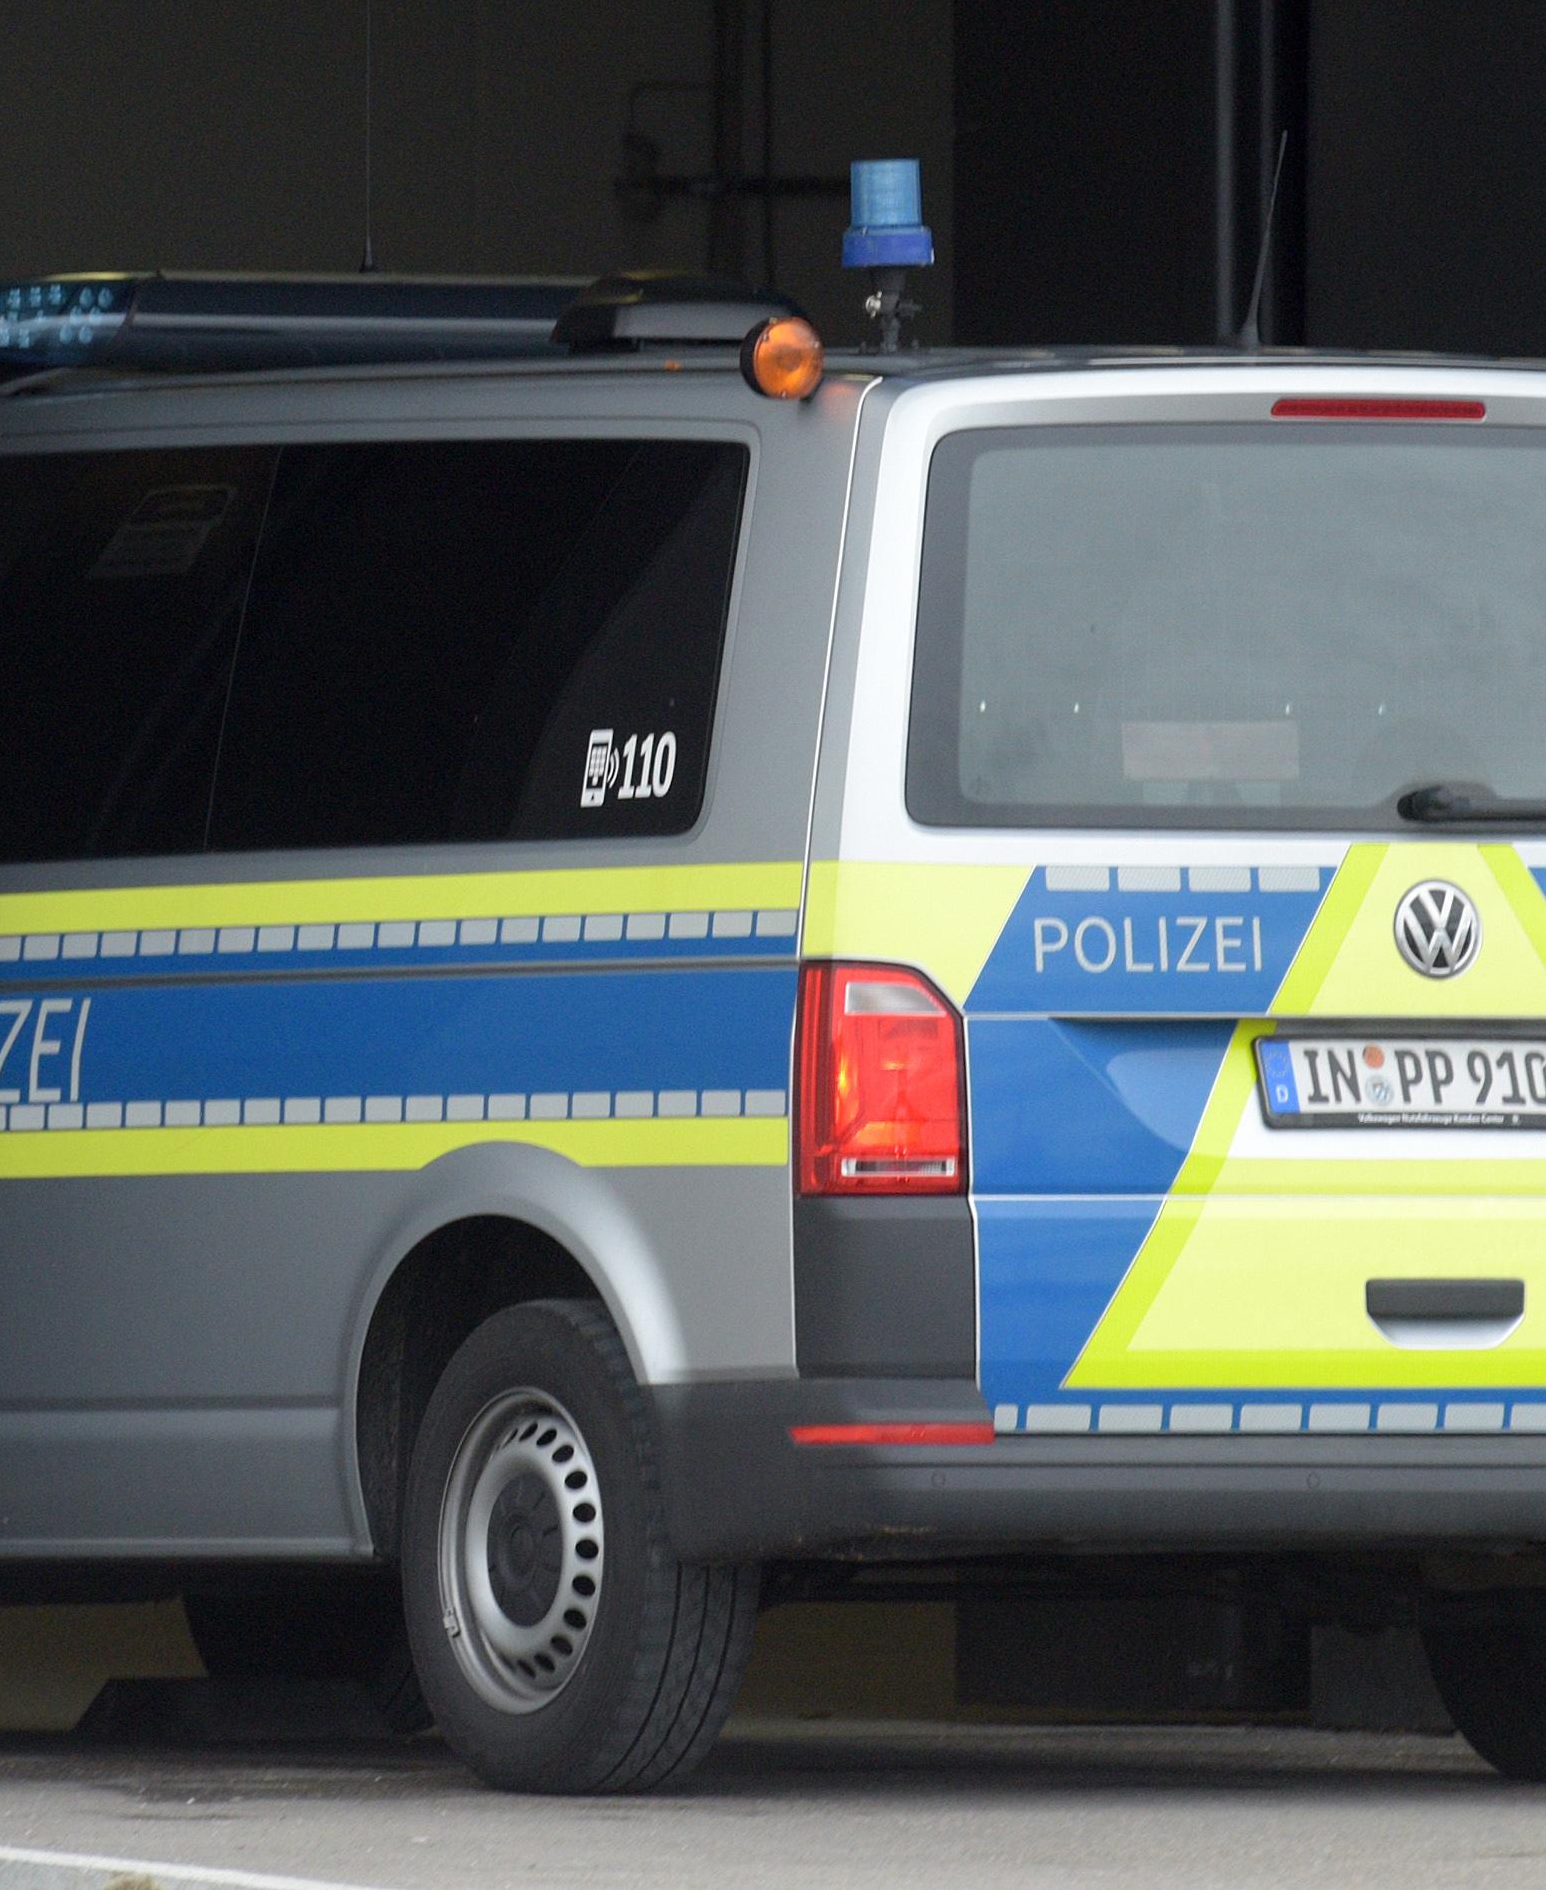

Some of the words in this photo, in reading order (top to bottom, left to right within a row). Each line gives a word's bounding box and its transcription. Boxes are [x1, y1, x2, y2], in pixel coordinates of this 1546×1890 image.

[617, 731, 677, 800] 110
[1033, 915, 1263, 974] POLIZEI
[1275, 1084, 1289, 1104] D
[1303, 1049, 1362, 1103] IN
[1394, 1049, 1455, 1105] PP
